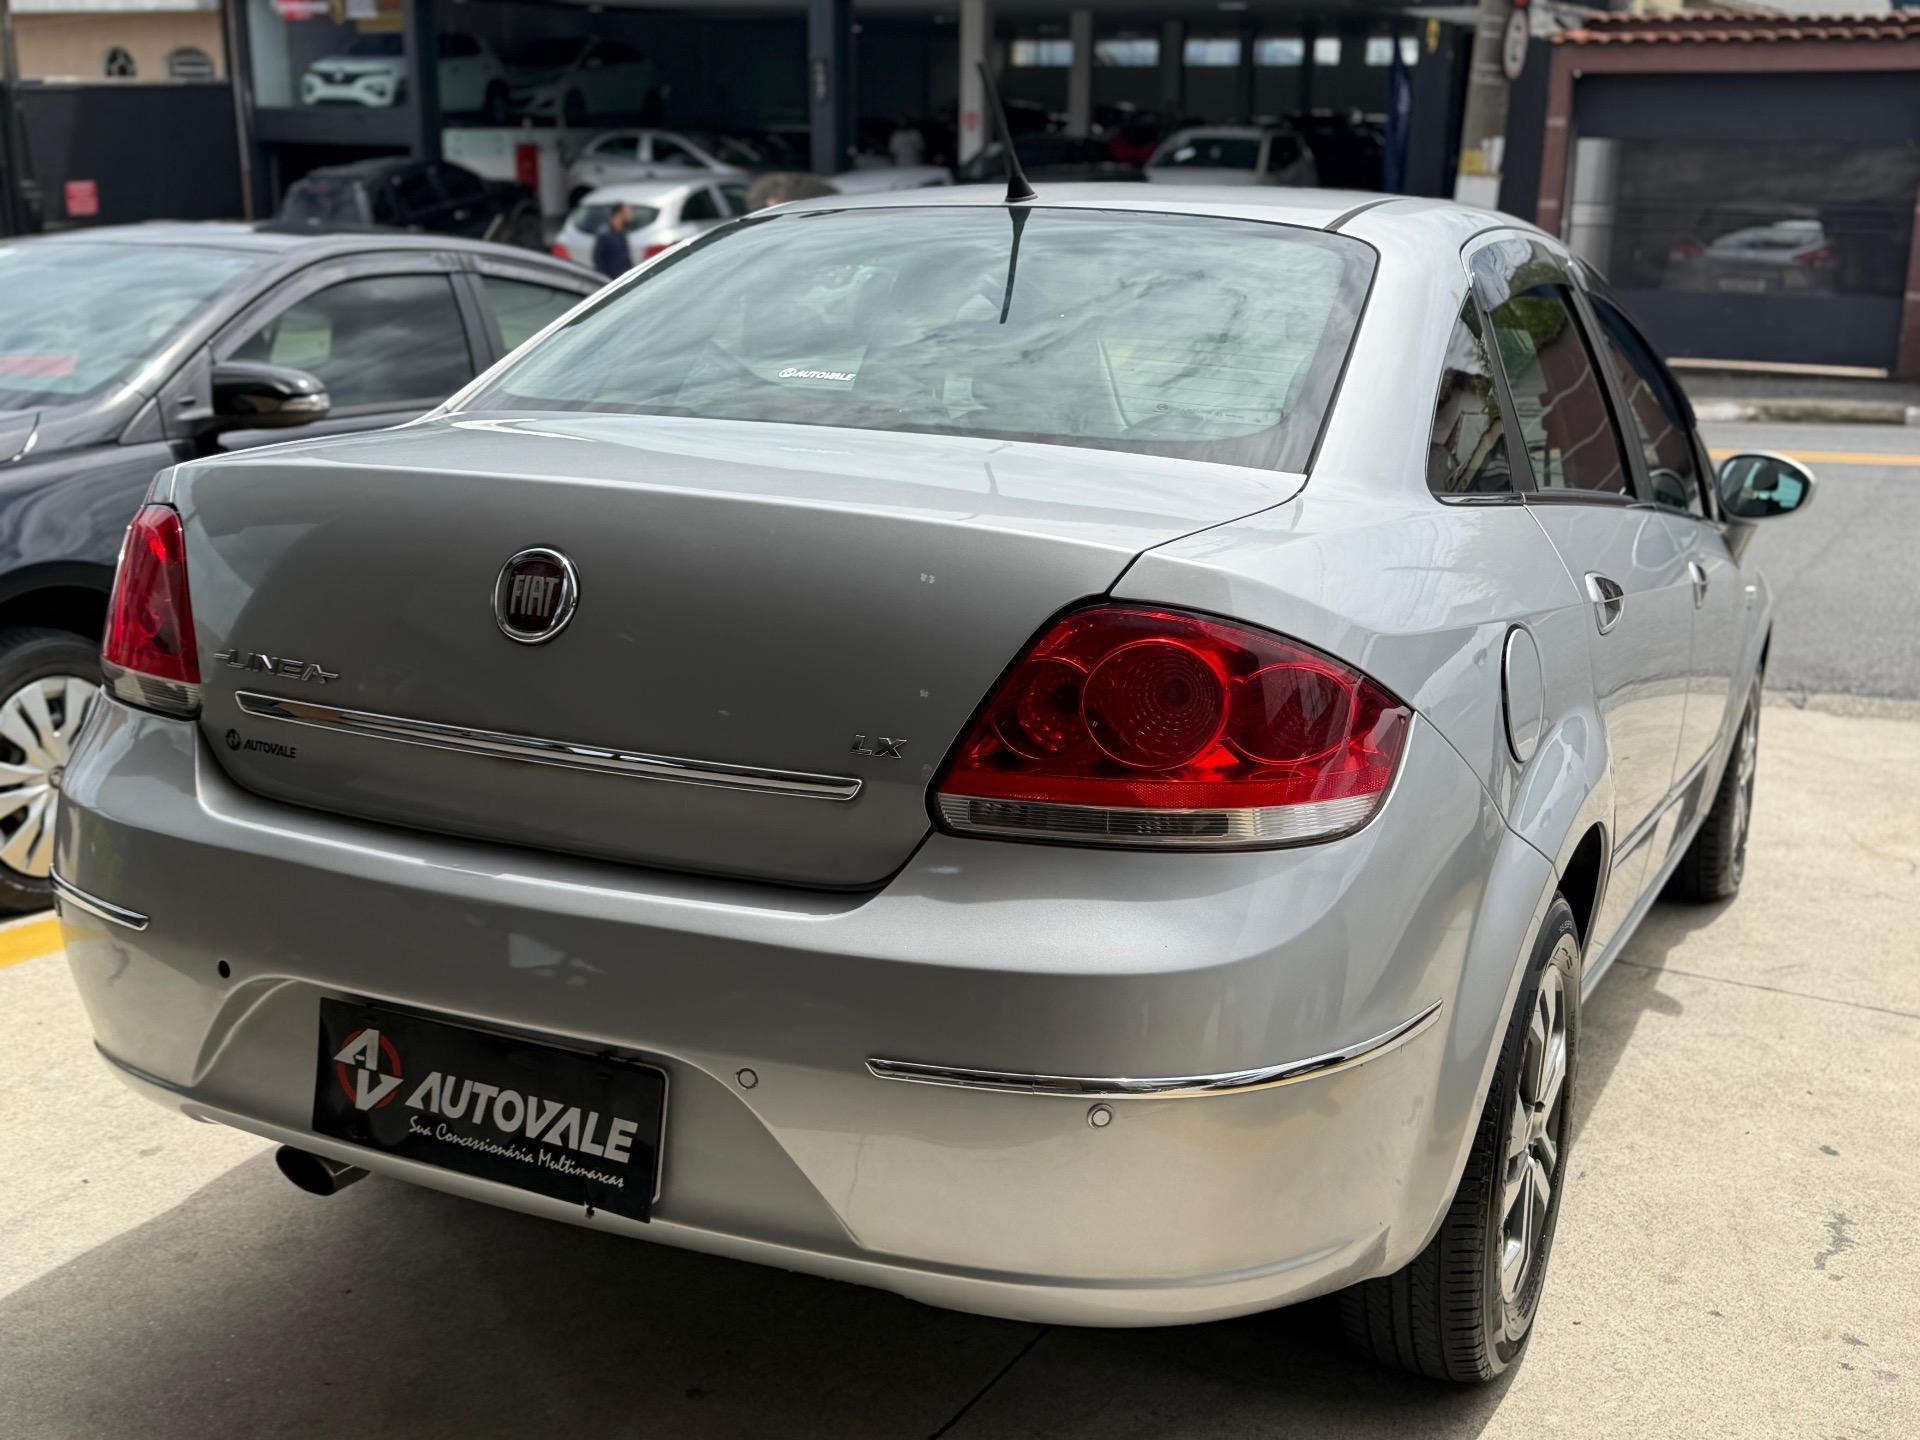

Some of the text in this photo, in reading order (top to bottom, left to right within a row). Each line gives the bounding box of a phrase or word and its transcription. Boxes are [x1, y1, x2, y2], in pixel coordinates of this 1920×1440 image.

[795, 369, 857, 381] AUTOVALE
[510, 574, 560, 617] FIAT
[213, 648, 339, 684] LINEA
[243, 738, 297, 759] AUTOVALE
[849, 733, 907, 759] LX
[404, 1071, 639, 1164] AUTOVALE
[408, 1115, 625, 1188] Sua Concessionária Multimarcas
